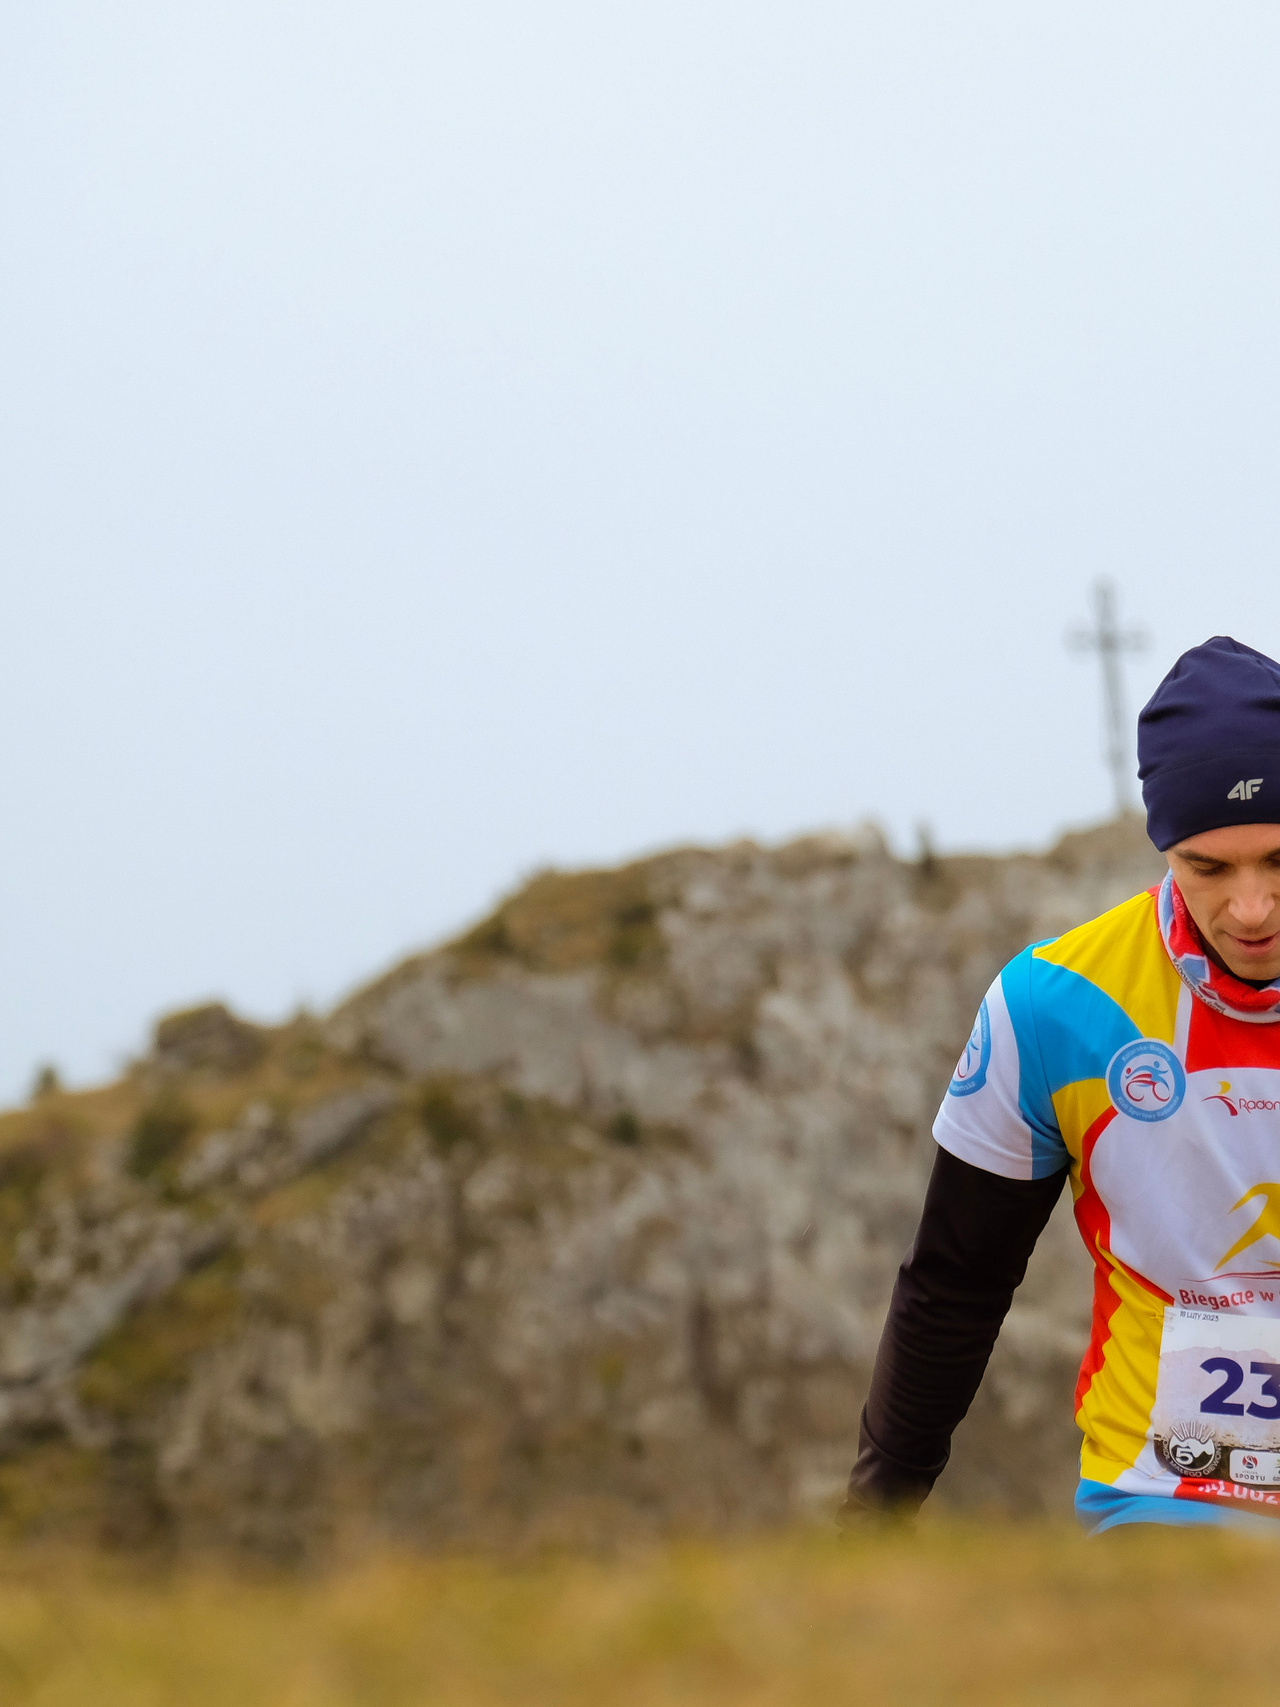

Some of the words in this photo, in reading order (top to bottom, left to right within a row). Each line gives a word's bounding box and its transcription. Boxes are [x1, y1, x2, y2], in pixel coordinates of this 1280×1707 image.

[1227, 778, 1264, 800] 4F
[1179, 1289, 1254, 1310] Biegacze
[1259, 1291, 1274, 1302] w
[1186, 1312, 1202, 1320] LUTY
[1202, 1314, 1219, 1322] 2023
[1171, 1420, 1215, 1443] CROSS
[1235, 1473, 1265, 1481] SPORTU
